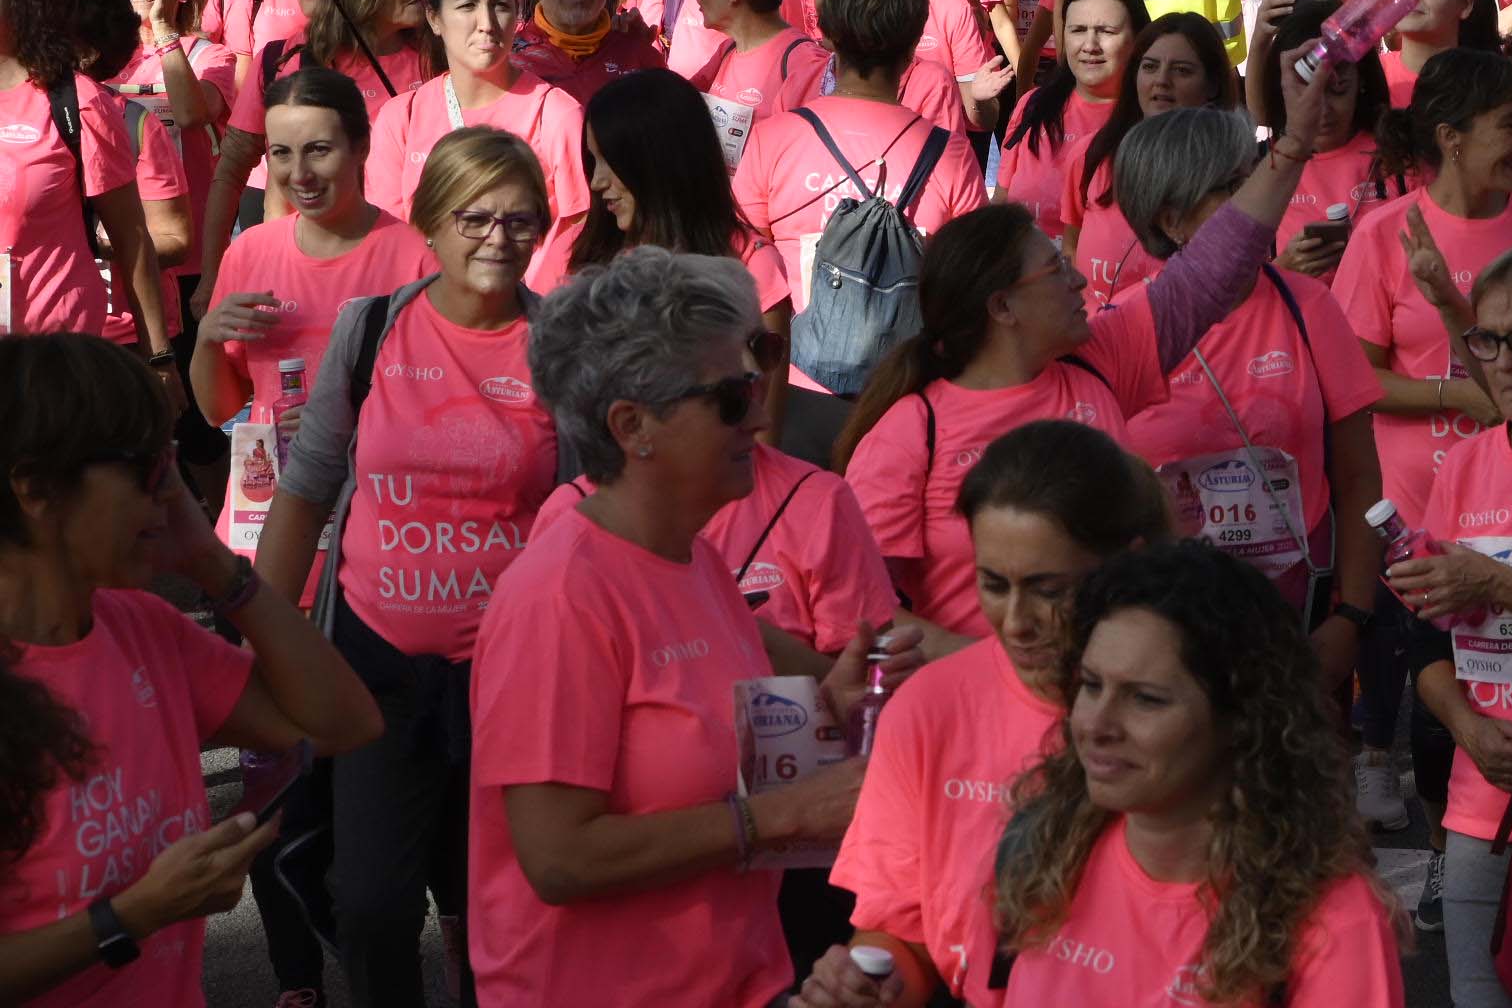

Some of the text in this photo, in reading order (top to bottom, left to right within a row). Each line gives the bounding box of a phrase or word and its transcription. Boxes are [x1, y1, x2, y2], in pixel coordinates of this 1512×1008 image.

[384, 364, 444, 381] OYSHO
[368, 473, 413, 505] TU
[1209, 503, 1257, 524] 016
[378, 519, 529, 553] DORSAL
[1219, 529, 1252, 542] 4299
[379, 566, 493, 601] SUMA
[1501, 641, 1512, 650] DE
[1466, 657, 1502, 673] OYSHO
[70, 768, 123, 821] HOY
